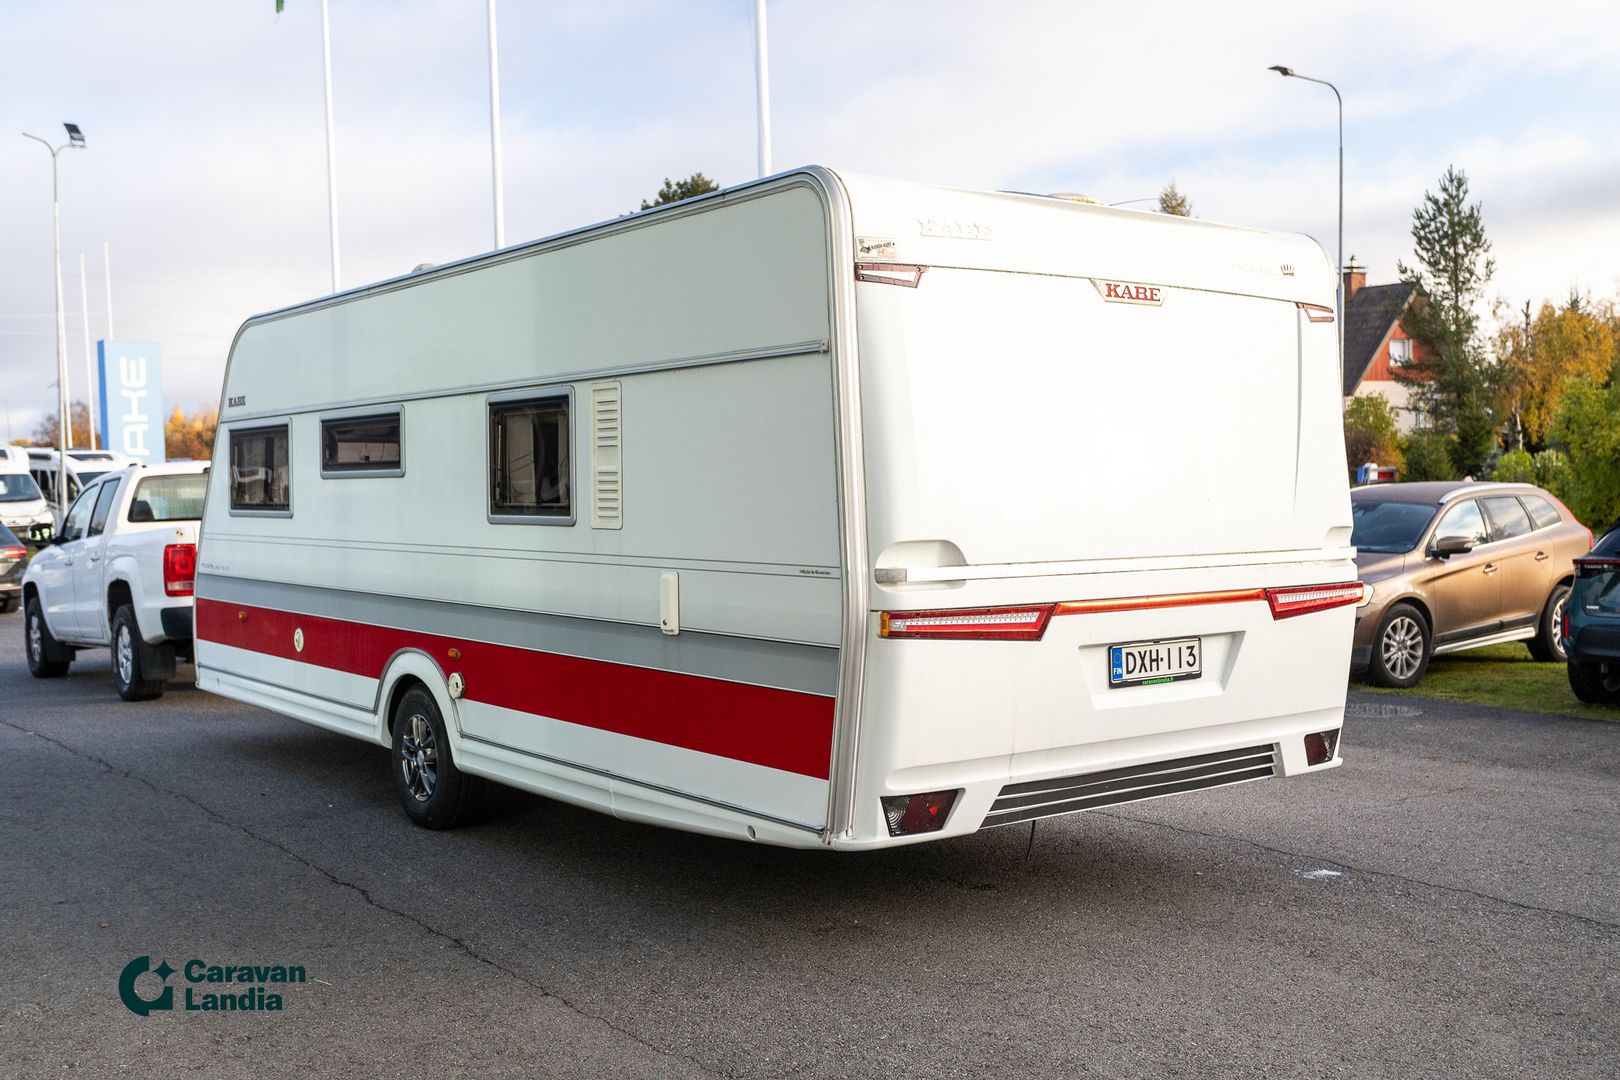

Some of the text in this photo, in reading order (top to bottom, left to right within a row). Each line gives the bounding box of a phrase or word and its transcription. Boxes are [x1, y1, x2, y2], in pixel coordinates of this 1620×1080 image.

[1105, 282, 1161, 302] KABE
[1125, 644, 1197, 675] DXH-113
[1113, 667, 1123, 675] FIN
